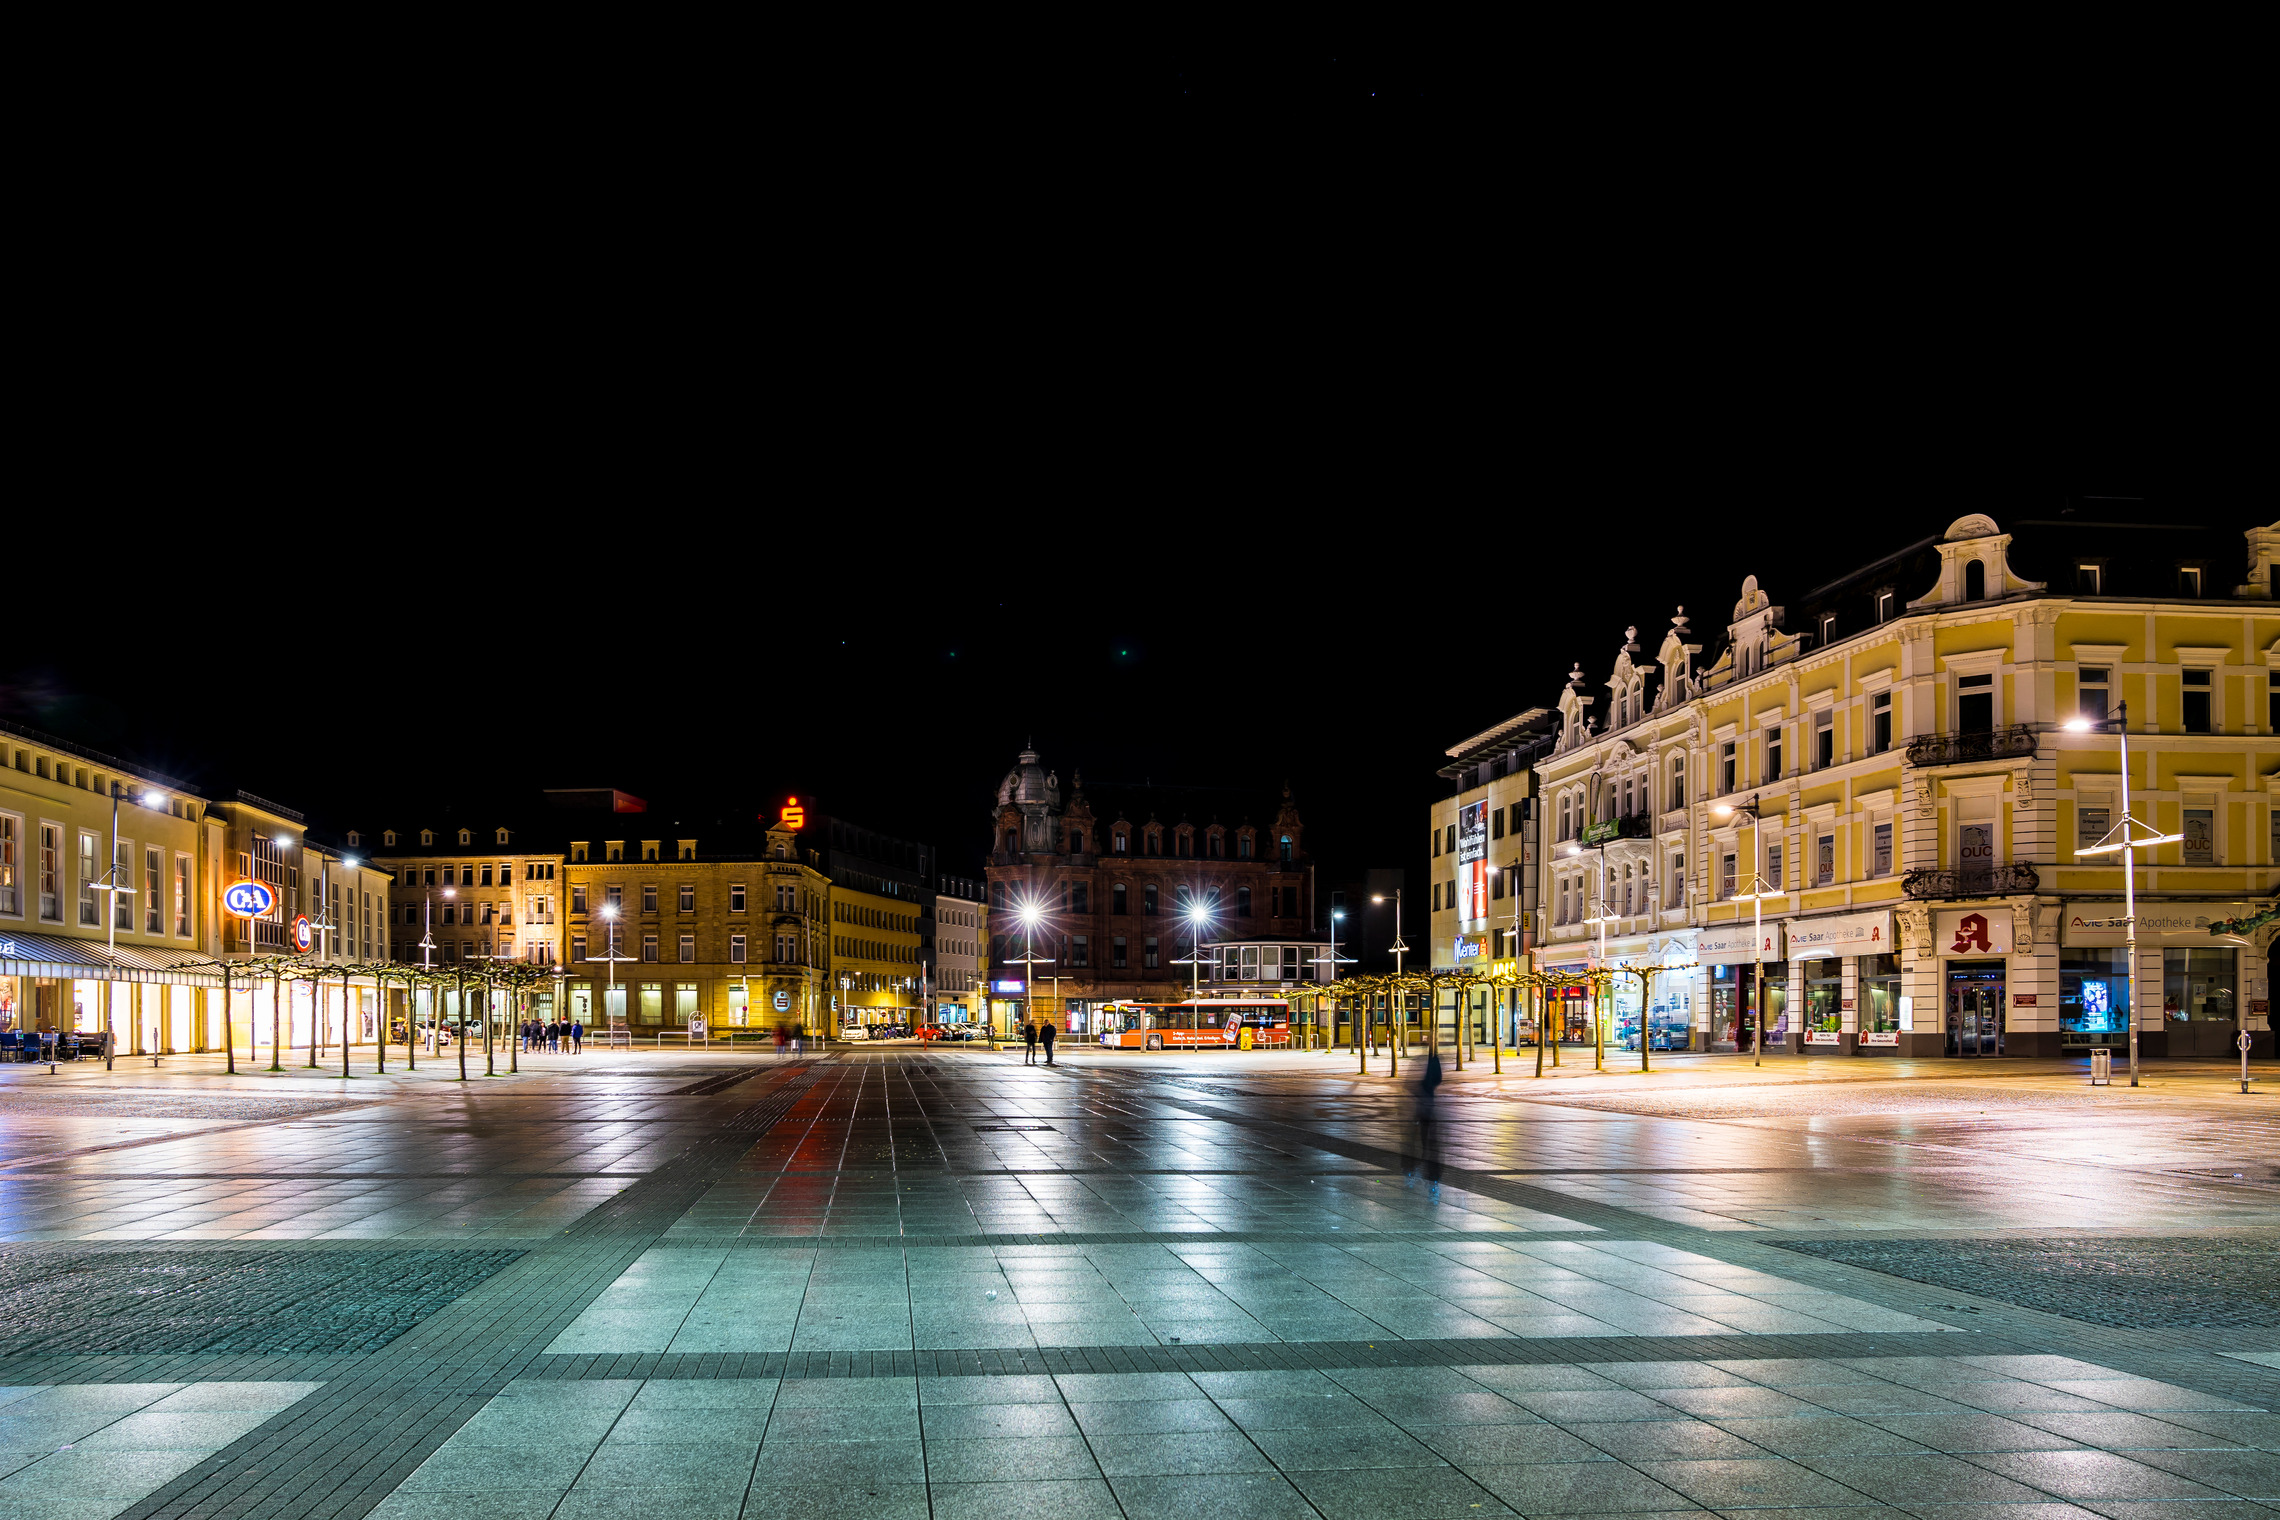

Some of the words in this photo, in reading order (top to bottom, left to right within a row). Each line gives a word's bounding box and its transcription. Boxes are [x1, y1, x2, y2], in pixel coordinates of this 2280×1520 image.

[1460, 833, 1485, 848] Wohlfühlen
[2184, 839, 2210, 850] OUC
[1466, 846, 1484, 860] einfach.
[1961, 846, 1993, 858] OUC
[2107, 916, 2130, 928] Saa
[2139, 916, 2191, 930] Apotheke
[1809, 932, 1824, 942] Saar
[1825, 929, 1853, 941] Apotheke
[1714, 941, 1727, 950] Saar
[1728, 940, 1750, 950] Apotheke
[1493, 961, 1517, 978] ADAC
